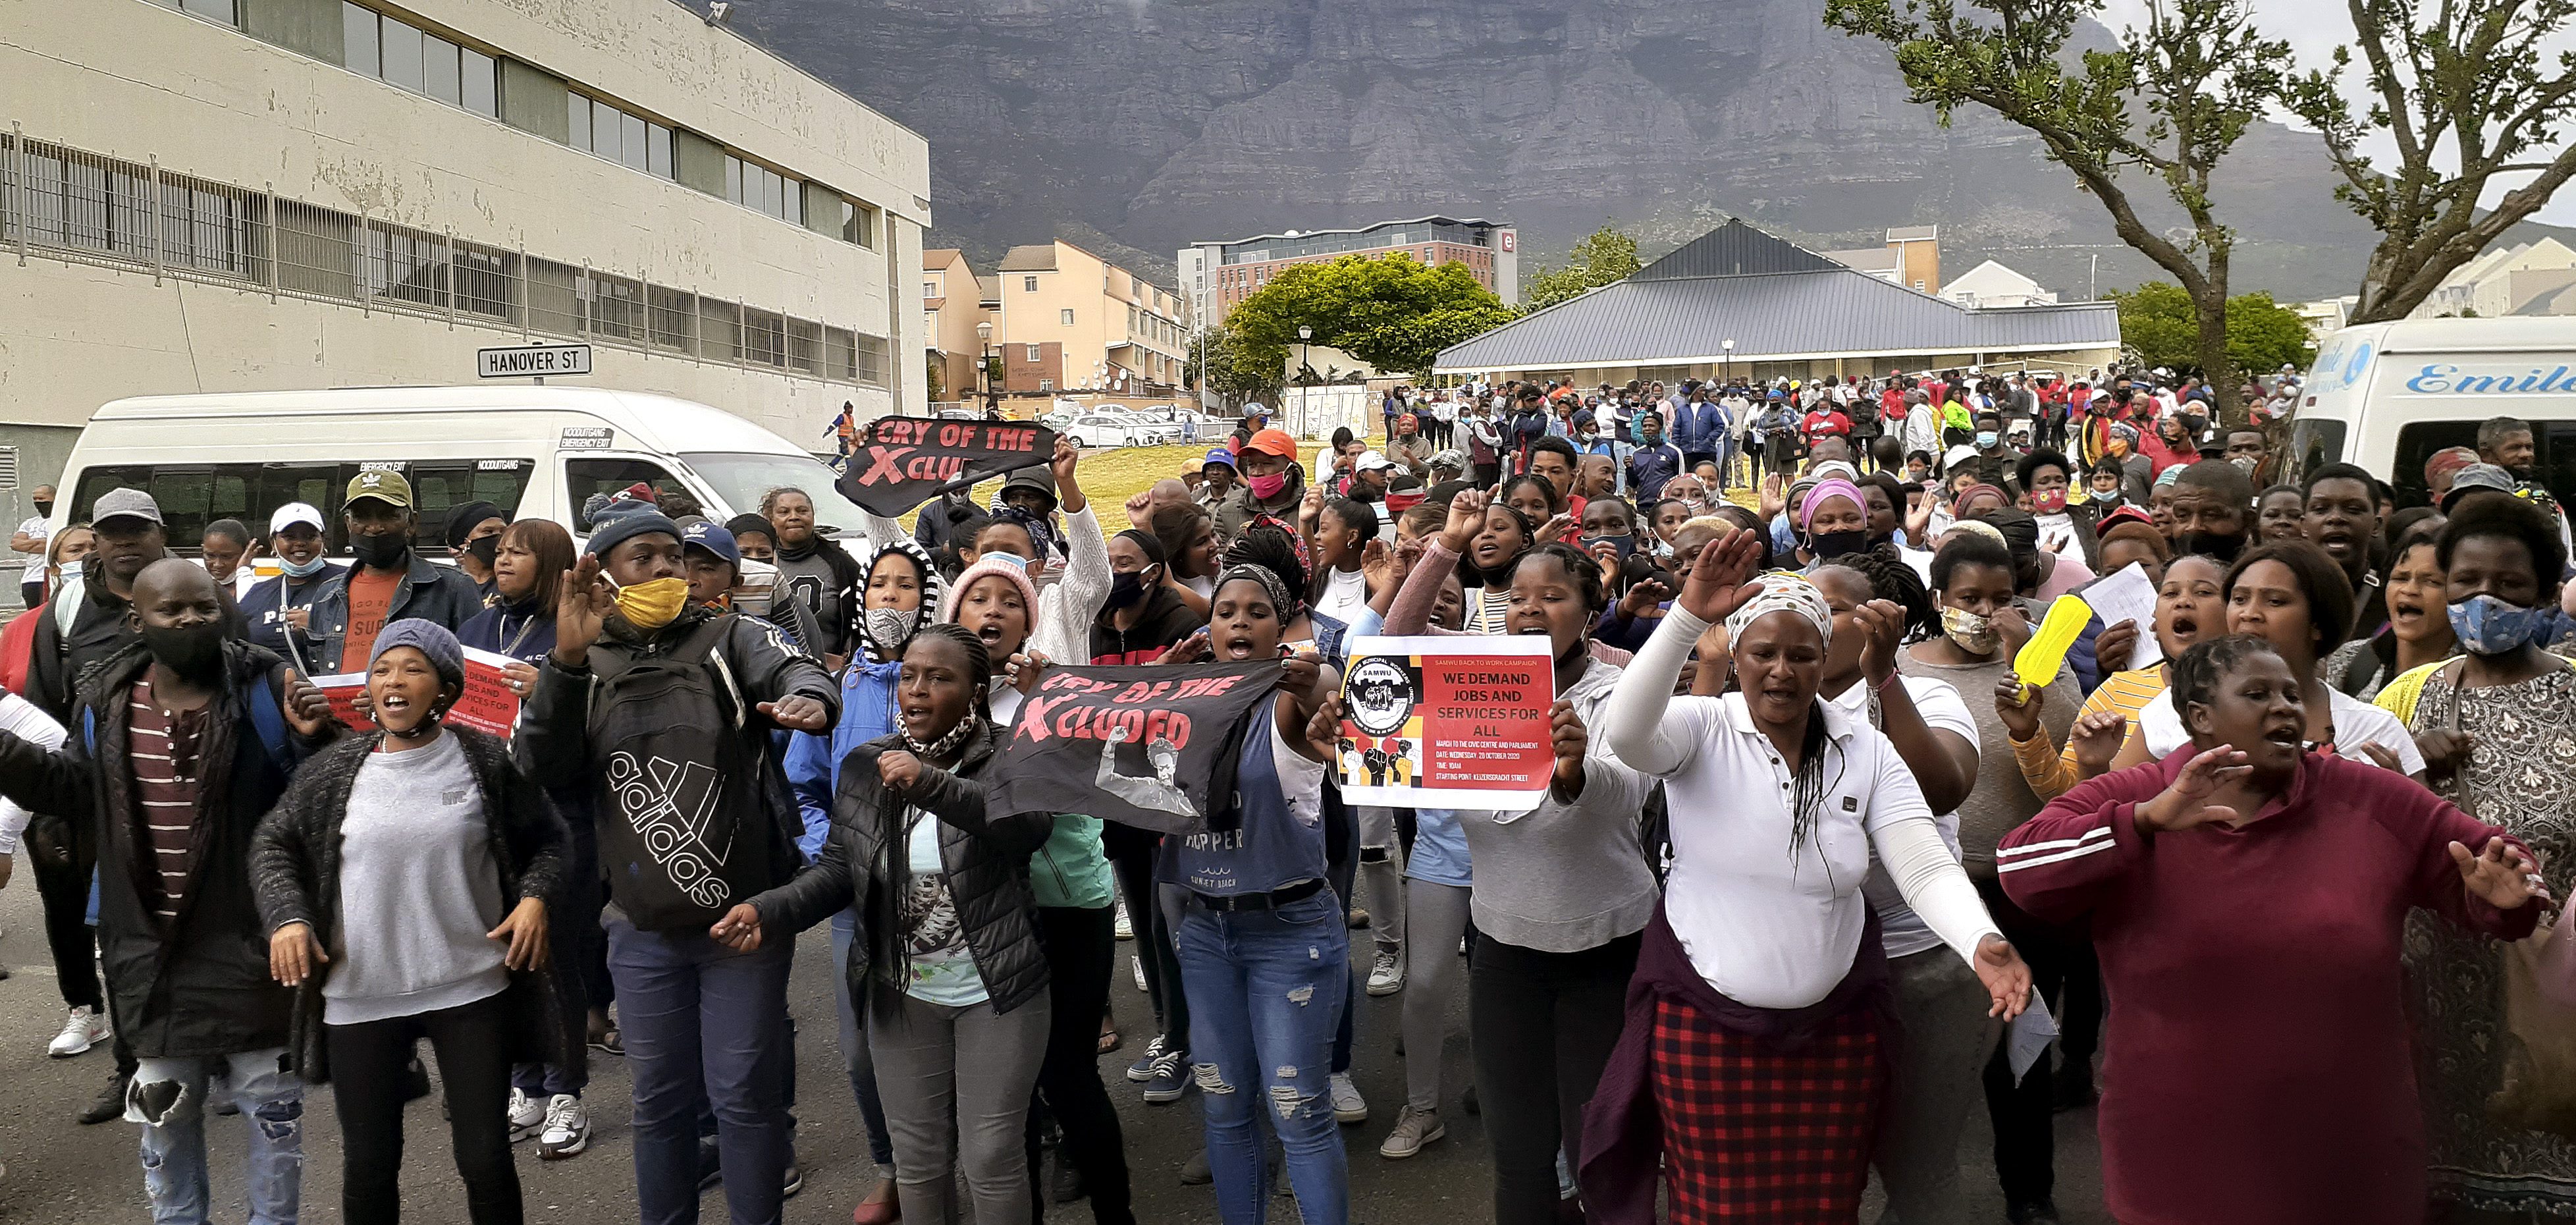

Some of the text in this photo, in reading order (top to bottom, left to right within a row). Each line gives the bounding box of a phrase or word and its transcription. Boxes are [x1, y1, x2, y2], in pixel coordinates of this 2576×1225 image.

[489, 350, 579, 372] HANOVER ST
[561, 439, 611, 447] EMERGENCY EXIT
[877, 421, 1038, 452] CRY OF THE
[393, 462, 406, 472] EXIT
[1348, 663, 1362, 683] AFRICAN
[1389, 661, 1410, 684] WORKERS
[1443, 672, 1530, 685] WE DEMAND
[1040, 672, 1245, 704] CRY OF THE
[1453, 690, 1522, 702] JOBS AND
[1437, 707, 1538, 720] SERVICES FOR
[1473, 724, 1501, 737] ALL
[606, 751, 730, 909] adidas
